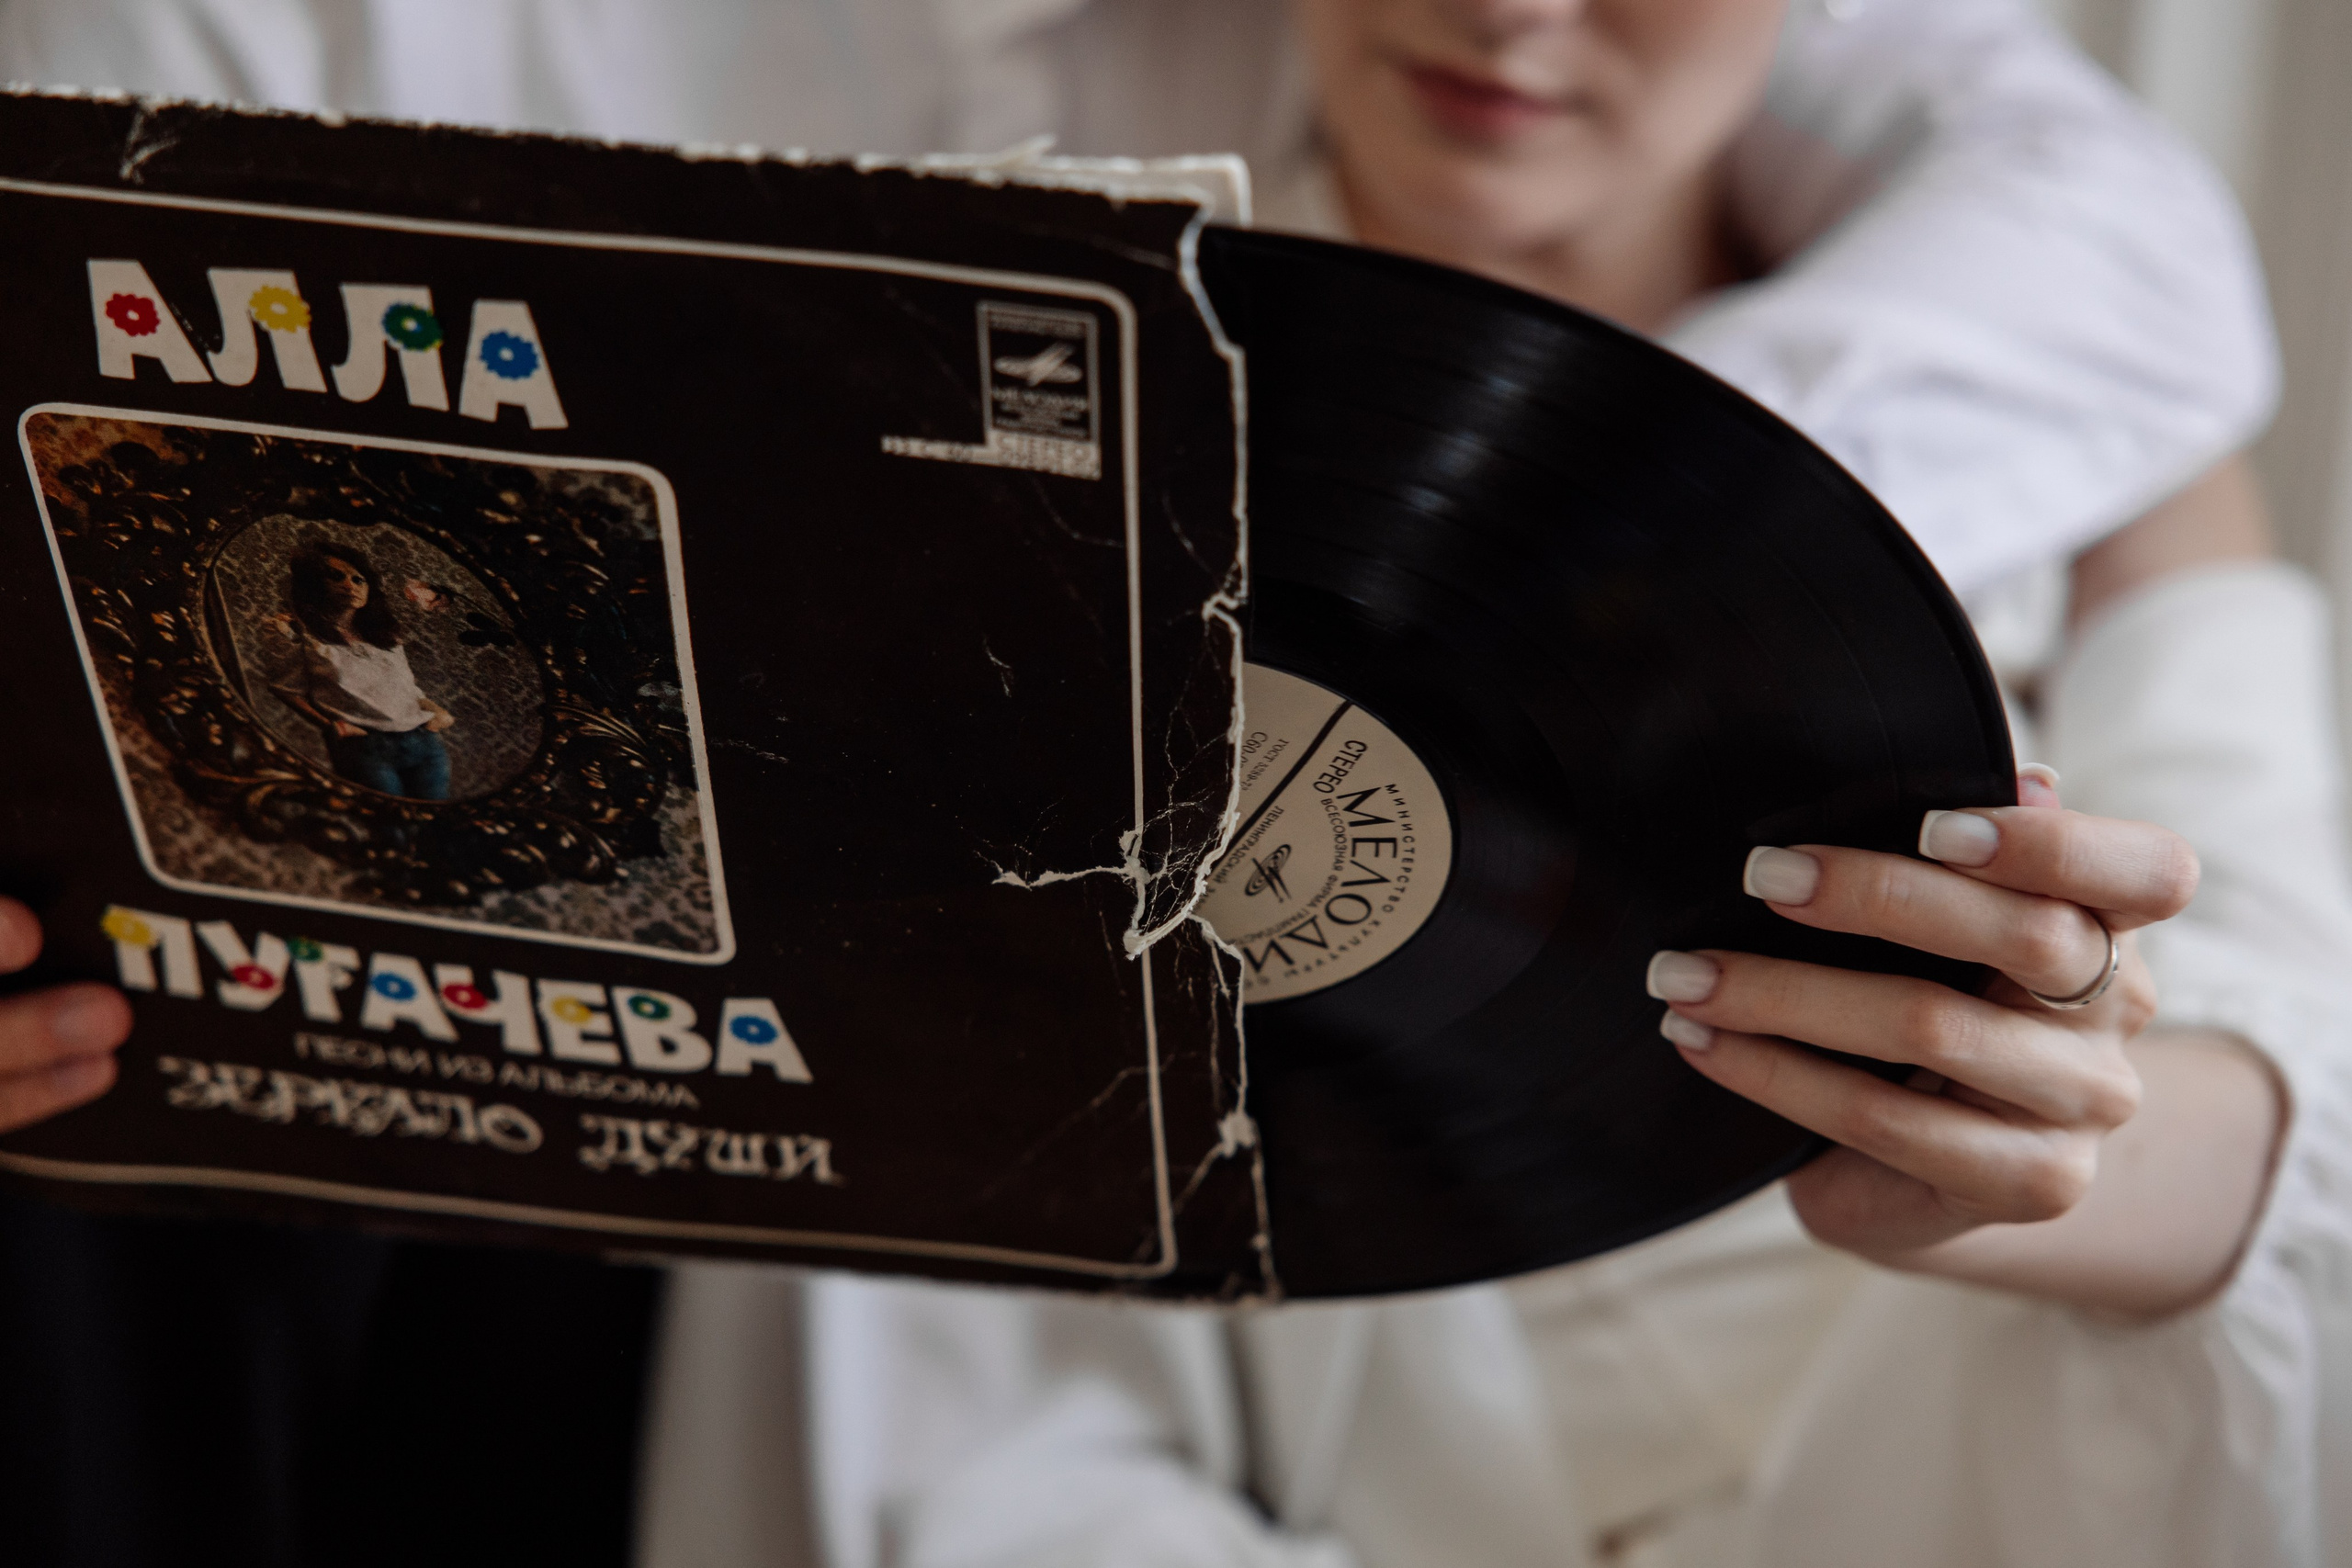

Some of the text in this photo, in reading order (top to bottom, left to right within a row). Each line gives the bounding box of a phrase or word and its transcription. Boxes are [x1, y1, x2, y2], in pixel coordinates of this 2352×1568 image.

[85, 257, 569, 430] АЛЛА
[1262, 738, 1290, 763] ГОСТ
[1313, 739, 1368, 794] СТЕРЕО
[1212, 806, 1283, 886] ЛЕНИНГРАДСКИЙ
[1320, 797, 1347, 872] ВСЕСОЮЗНАЯ
[1381, 783, 1416, 913] МИНИСТЕРСТВО
[1308, 874, 1339, 909] ФИРМА
[101, 905, 813, 1084] ПУГАЧЕВА
[295, 1032, 700, 1109] ПЕСНИ ИЗ АЛЬБОМА
[577, 1112, 845, 1187] ДУШИ
